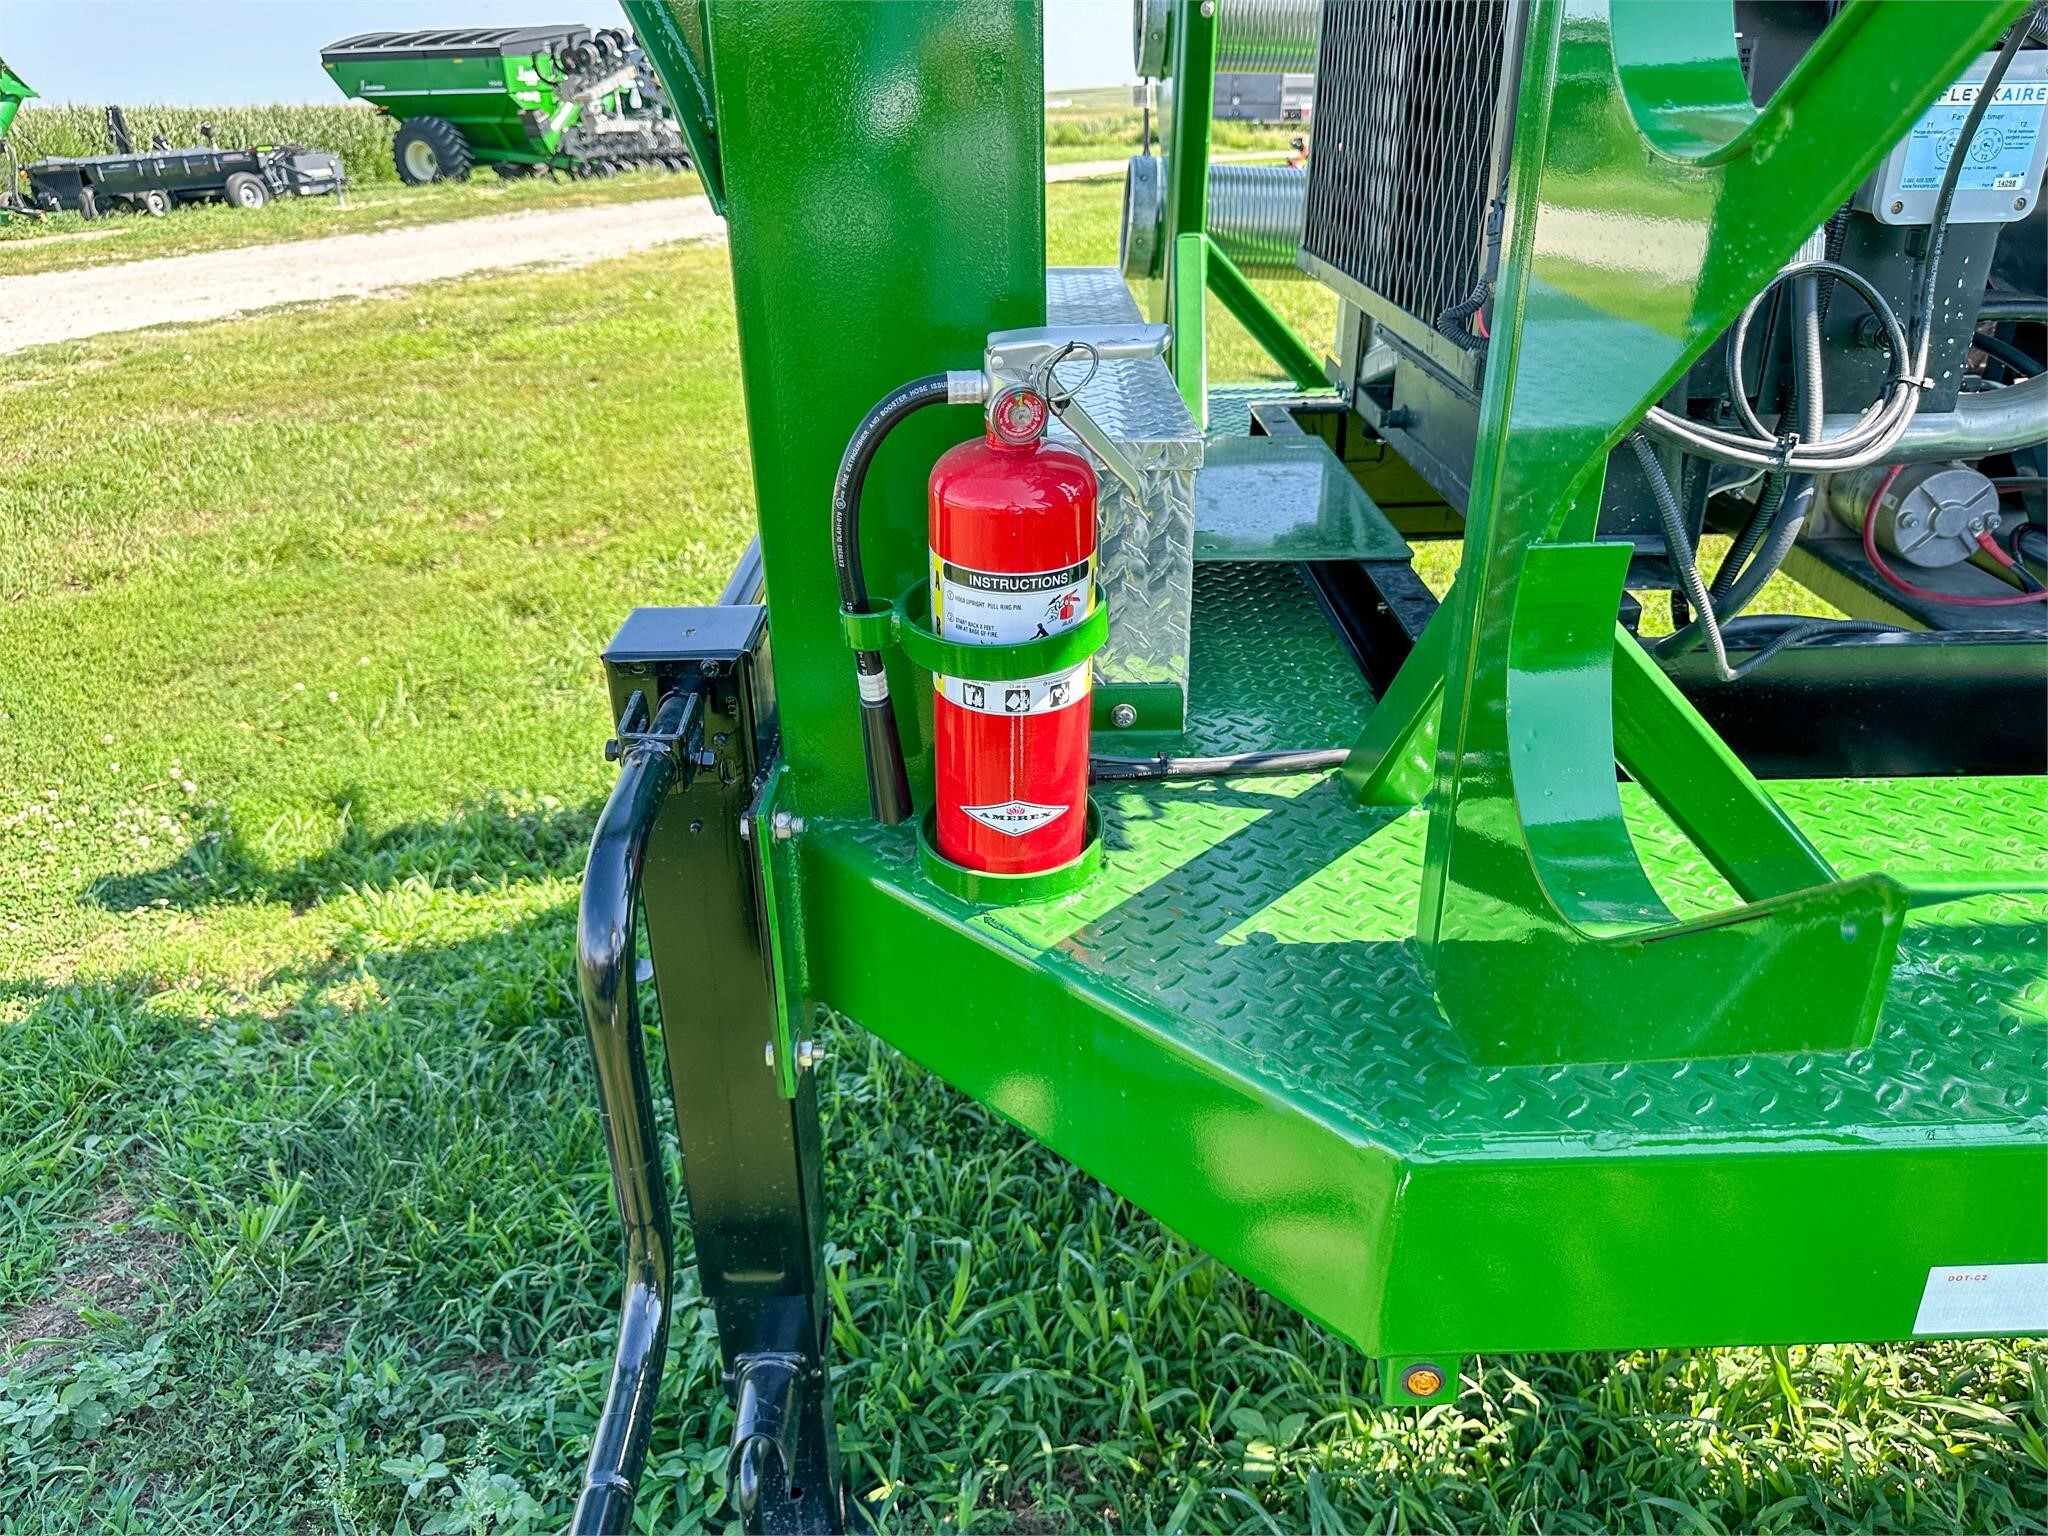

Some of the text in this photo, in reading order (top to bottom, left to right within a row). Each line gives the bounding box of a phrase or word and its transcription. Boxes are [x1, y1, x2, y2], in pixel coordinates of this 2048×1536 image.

[845, 430, 870, 473] EXTINGUISHER
[868, 416, 880, 430] AND
[879, 394, 908, 417] BOOSTER
[909, 384, 929, 397] HOSE
[969, 573, 1069, 591] INSTRUCTIONS
[968, 621, 979, 629] BACK
[980, 811, 1052, 821] AMEREX
[1948, 1274, 1988, 1282] DOT-C2
